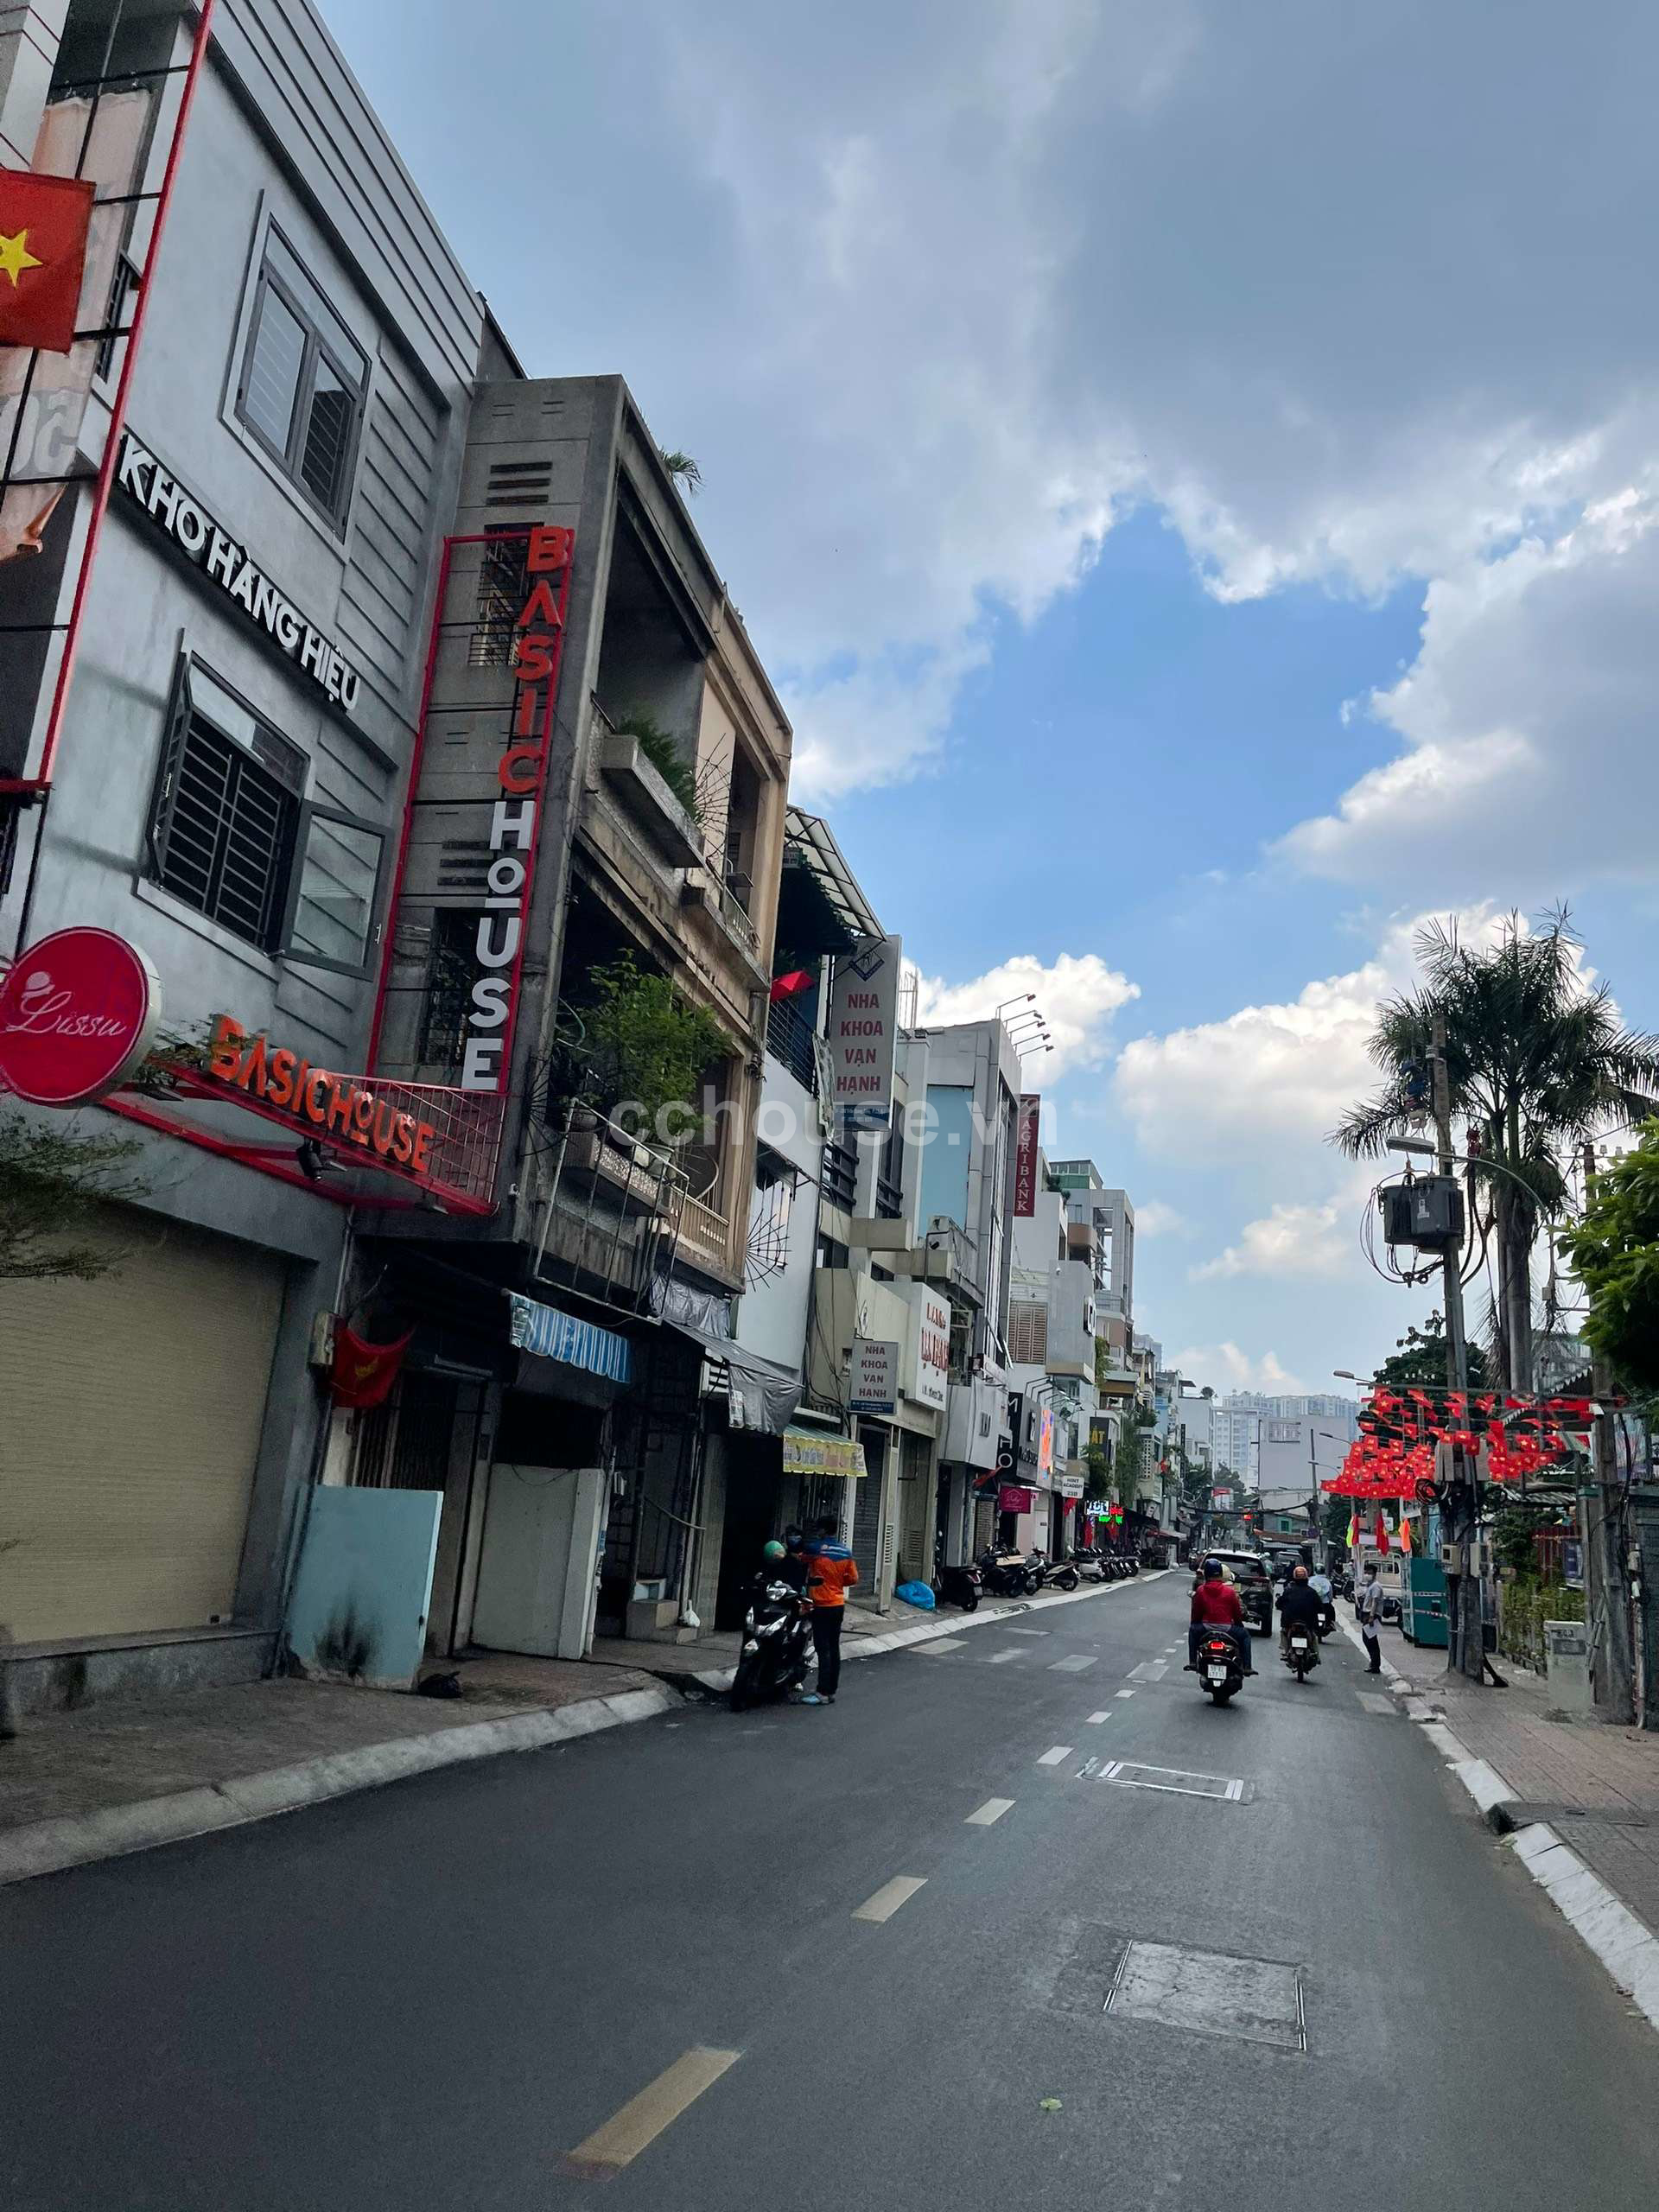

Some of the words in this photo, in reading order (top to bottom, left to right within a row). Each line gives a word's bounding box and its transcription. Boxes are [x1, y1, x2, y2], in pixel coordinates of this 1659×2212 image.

[119, 434, 206, 551] KHO
[207, 529, 300, 649] HÀNG
[300, 624, 360, 710] HIỆU
[498, 525, 570, 794] BASIC
[848, 993, 880, 1009] NHA
[840, 1020, 884, 1037] KHOA
[845, 1048, 877, 1067] VẠN
[836, 1076, 881, 1095] HẠNH
[1018, 1119, 1033, 1211] AGRIBANK
[865, 1345, 886, 1356] NHA
[861, 1359, 888, 1370] KHOA
